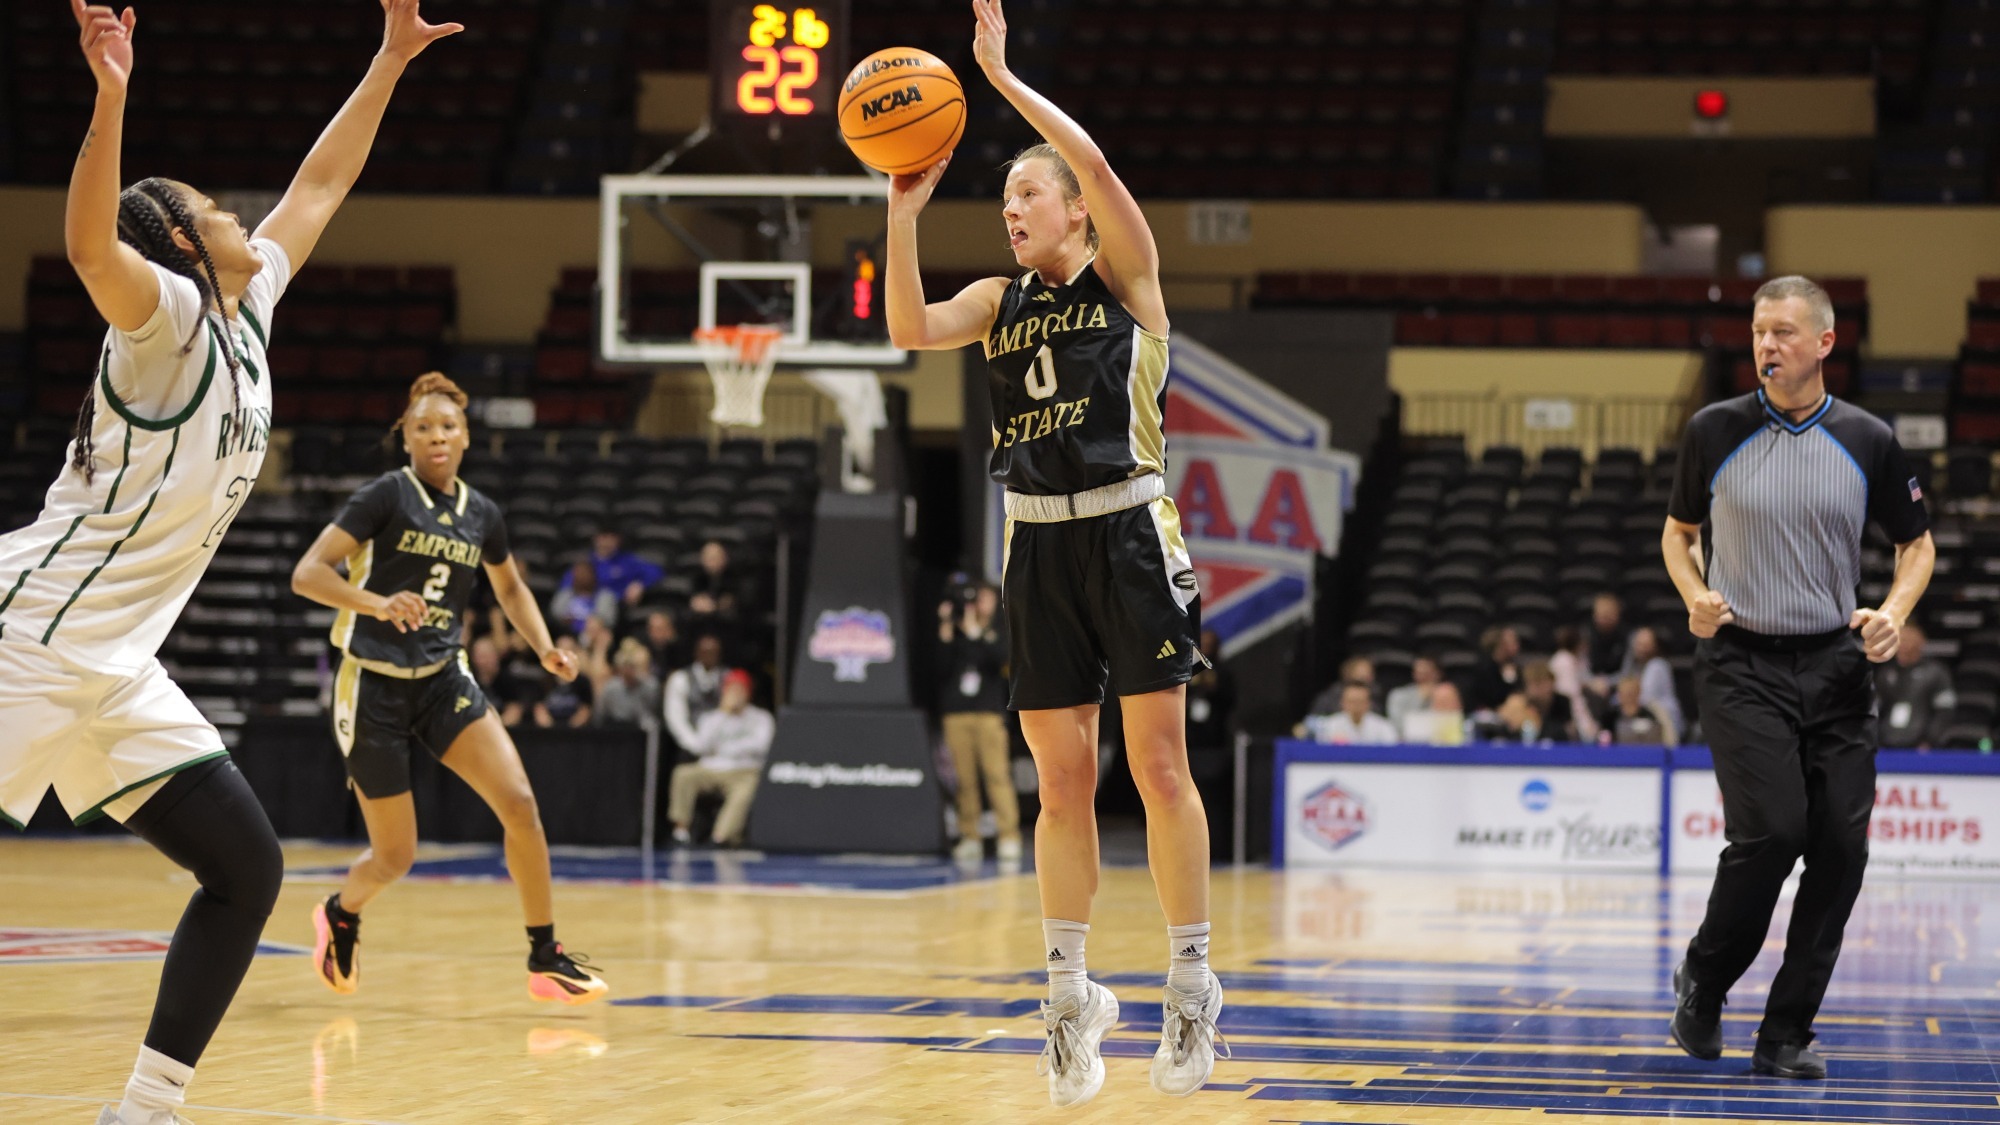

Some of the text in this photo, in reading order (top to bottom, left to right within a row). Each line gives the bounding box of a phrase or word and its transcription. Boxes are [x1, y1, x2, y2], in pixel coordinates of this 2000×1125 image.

[737, 45, 818, 115] 22
[861, 83, 923, 121] NCAA
[1024, 344, 1058, 400] 0
[1004, 397, 1090, 448] STATE
[423, 563, 451, 601] 2
[1457, 827, 1525, 848] MAKE
[1532, 828, 1555, 848] IT
